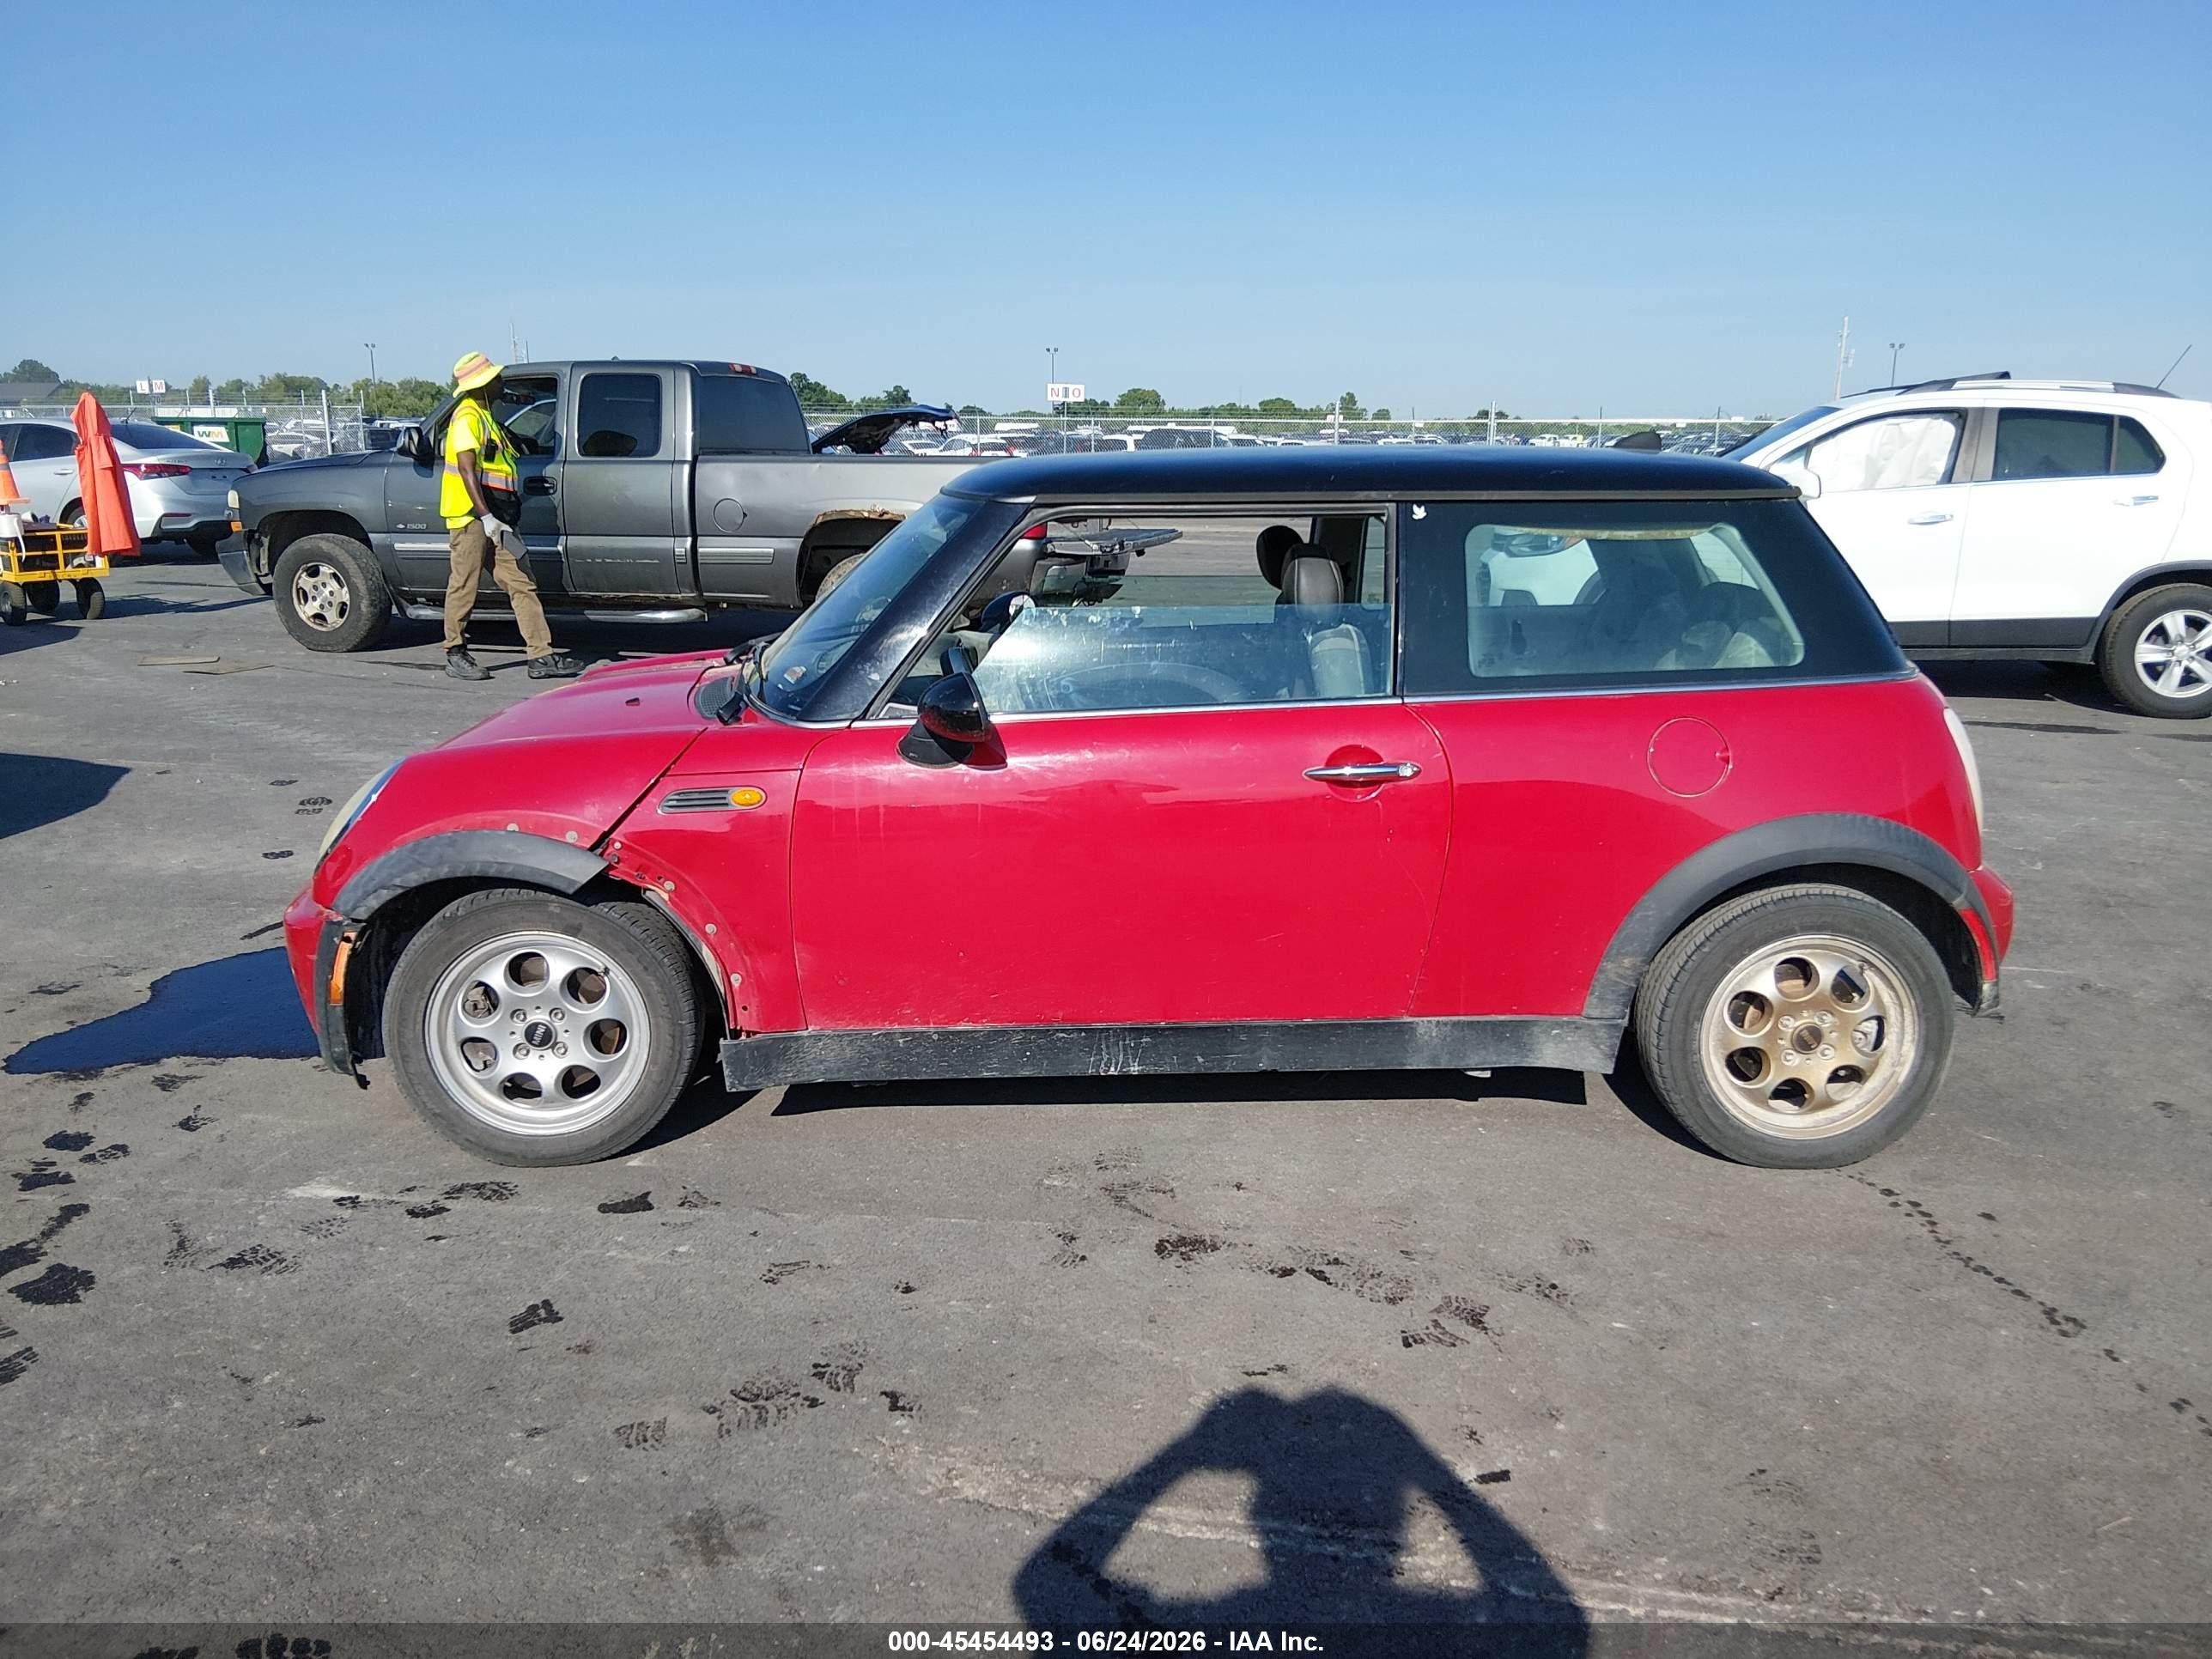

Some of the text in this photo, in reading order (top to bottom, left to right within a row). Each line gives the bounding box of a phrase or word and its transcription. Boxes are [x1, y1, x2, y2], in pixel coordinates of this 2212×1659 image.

[155, 381, 163, 391] M
[1051, 387, 1060, 398] N
[198, 430, 222, 440] WM
[531, 1024, 547, 1045] MINI
